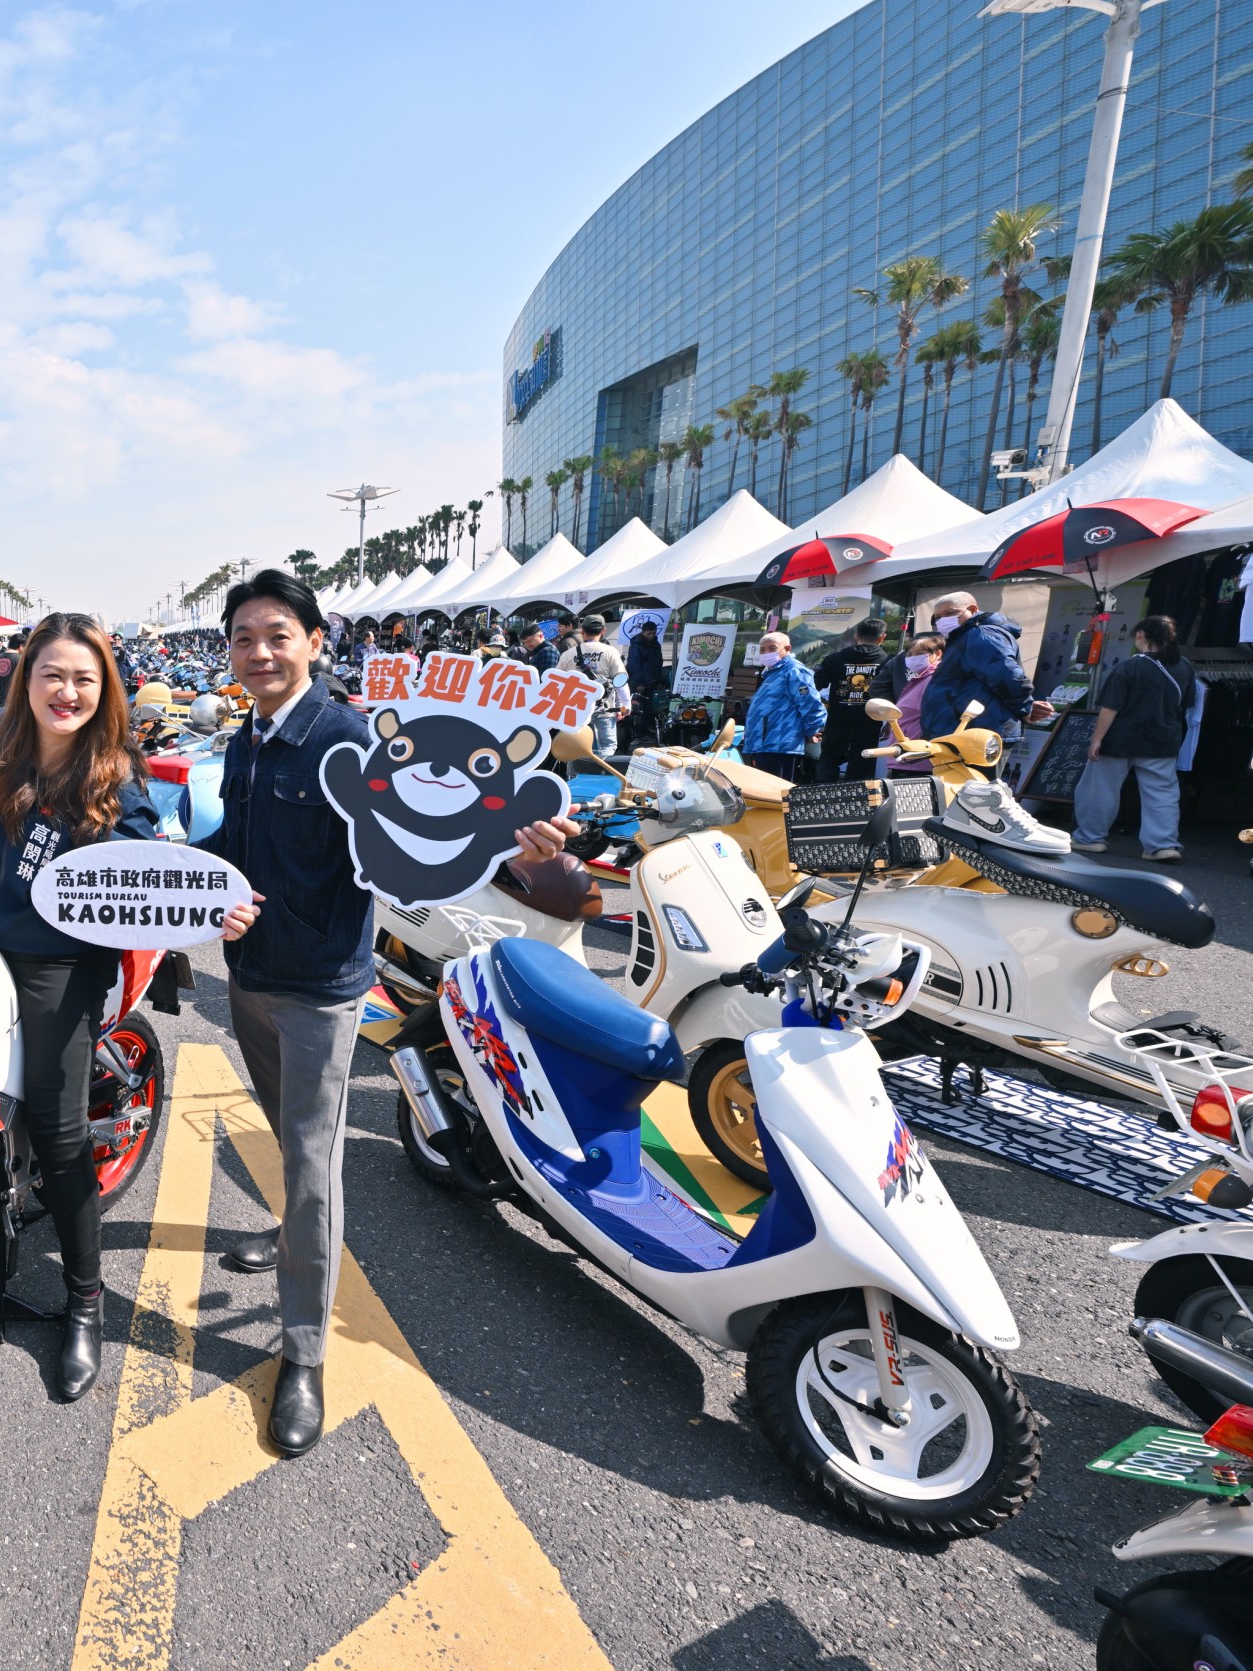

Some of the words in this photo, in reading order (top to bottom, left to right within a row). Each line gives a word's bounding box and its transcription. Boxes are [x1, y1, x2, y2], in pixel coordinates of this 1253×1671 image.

[691, 635, 723, 648] KIMOCHI
[681, 665, 723, 678] Kimochi
[365, 654, 598, 728] 歡迎你來
[849, 691, 864, 699] RIDE
[16, 822, 51, 882] 高閔琳
[38, 830, 61, 873] 觀光局局
[55, 866, 228, 891] 高雄市政府觀光局
[57, 891, 102, 901] TOURISM
[105, 893, 148, 901] BUREAU
[58, 903, 225, 928] KAOHSIUNG
[114, 1118, 131, 1136] RK
[993, 1335, 1017, 1343] HONDA
